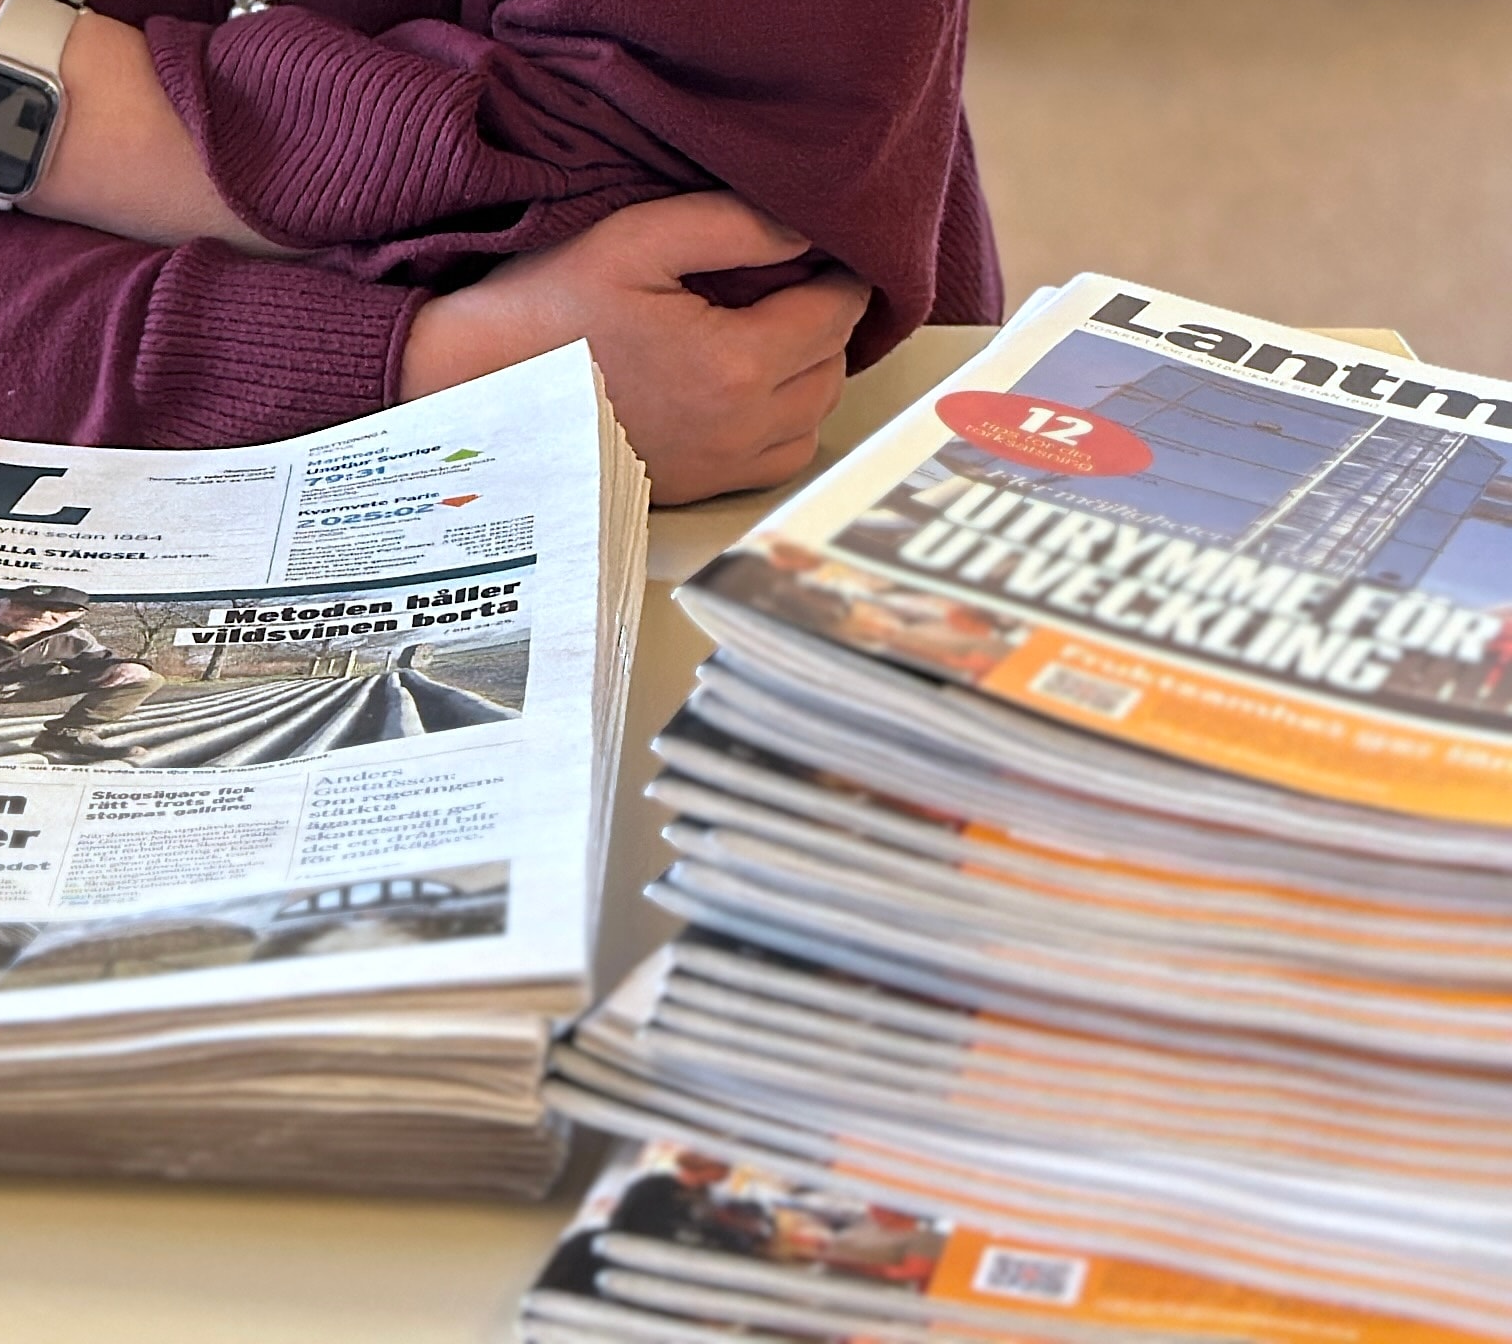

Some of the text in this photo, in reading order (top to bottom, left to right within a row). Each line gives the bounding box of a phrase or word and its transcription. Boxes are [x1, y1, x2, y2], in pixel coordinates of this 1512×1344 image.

[1019, 406, 1094, 447] 12
[306, 445, 442, 475] Ungtjur Sverige
[298, 492, 440, 516] Kvarnvete Paris
[45, 531, 108, 541] sedan
[114, 533, 162, 542] 1884
[44, 547, 150, 560] STÄNGSEL
[942, 483, 1500, 662] UTRYMME FÖR
[224, 580, 522, 624] Metoden håller
[900, 519, 1405, 693] UTVECKLING
[192, 617, 398, 645] vildsvinen
[411, 598, 519, 629] borta
[311, 775, 505, 808] Om regeringens
[313, 773, 457, 797] Gustafsson:
[316, 768, 404, 787] Anders
[88, 800, 128, 810] rätt
[154, 798, 205, 807] trots
[212, 794, 245, 804] det
[91, 786, 256, 801] Skogsägare fick
[86, 803, 253, 820] stoppas gallring
[306, 801, 486, 831] äganderätt ger
[308, 803, 397, 819] stärkta
[302, 823, 497, 854] det ett dråpslag
[304, 811, 499, 842] skattesmäll blir
